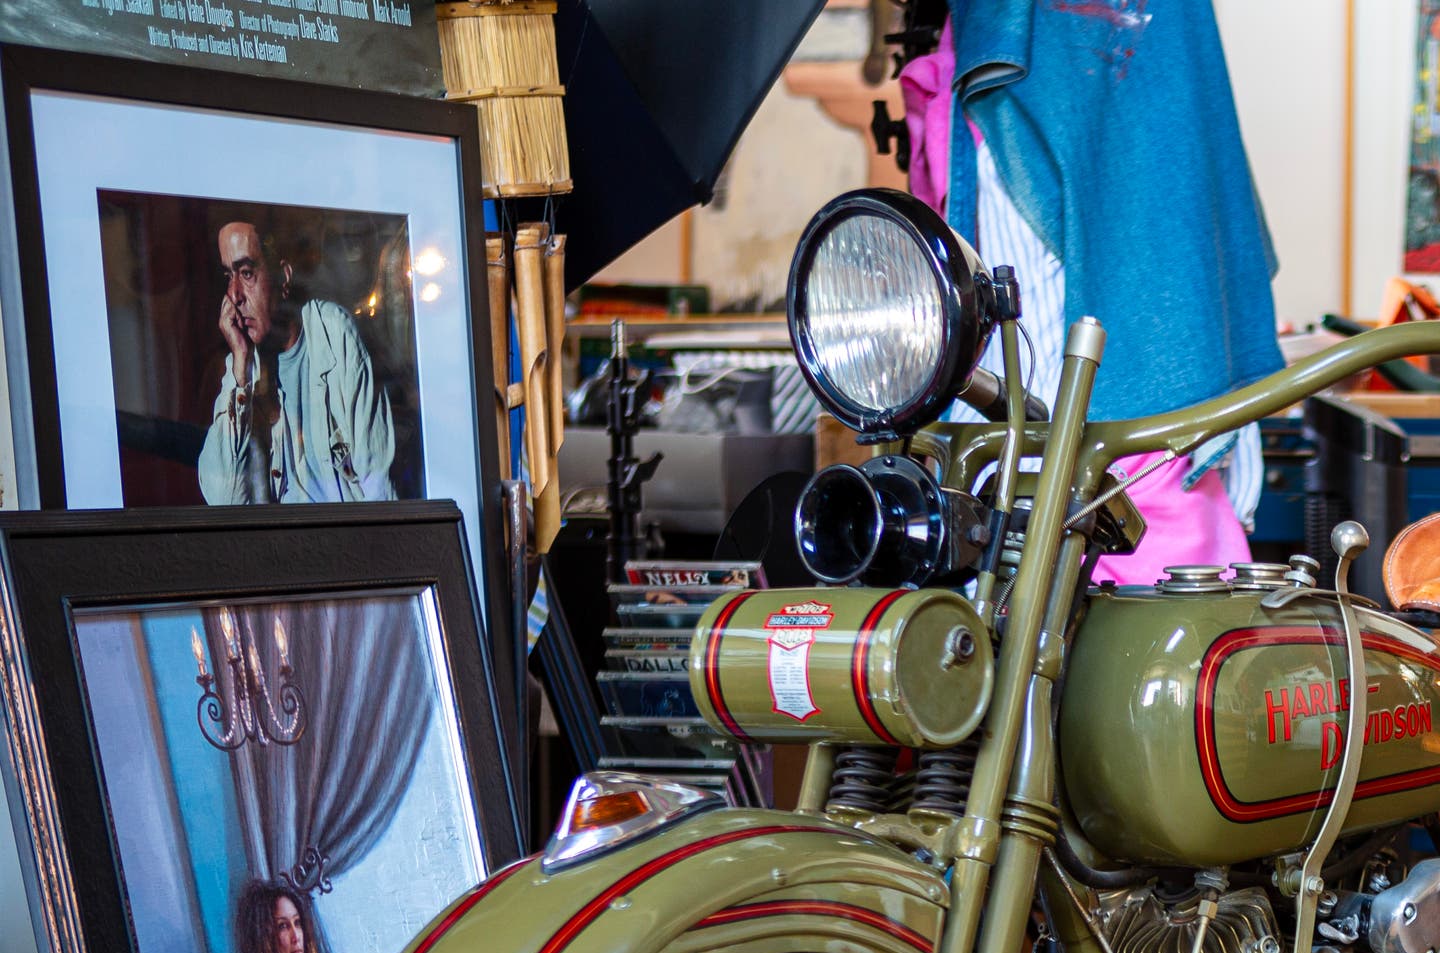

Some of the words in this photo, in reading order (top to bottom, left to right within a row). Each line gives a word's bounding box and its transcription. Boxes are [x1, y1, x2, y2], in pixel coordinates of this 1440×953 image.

[205, 0, 234, 32] Douglas
[300, 14, 317, 39] Dave
[317, 16, 339, 42] Starks
[391, 1, 412, 27] Arnold
[1264, 678, 1380, 745] HARLE-
[1320, 701, 1432, 771] DVIDSON
